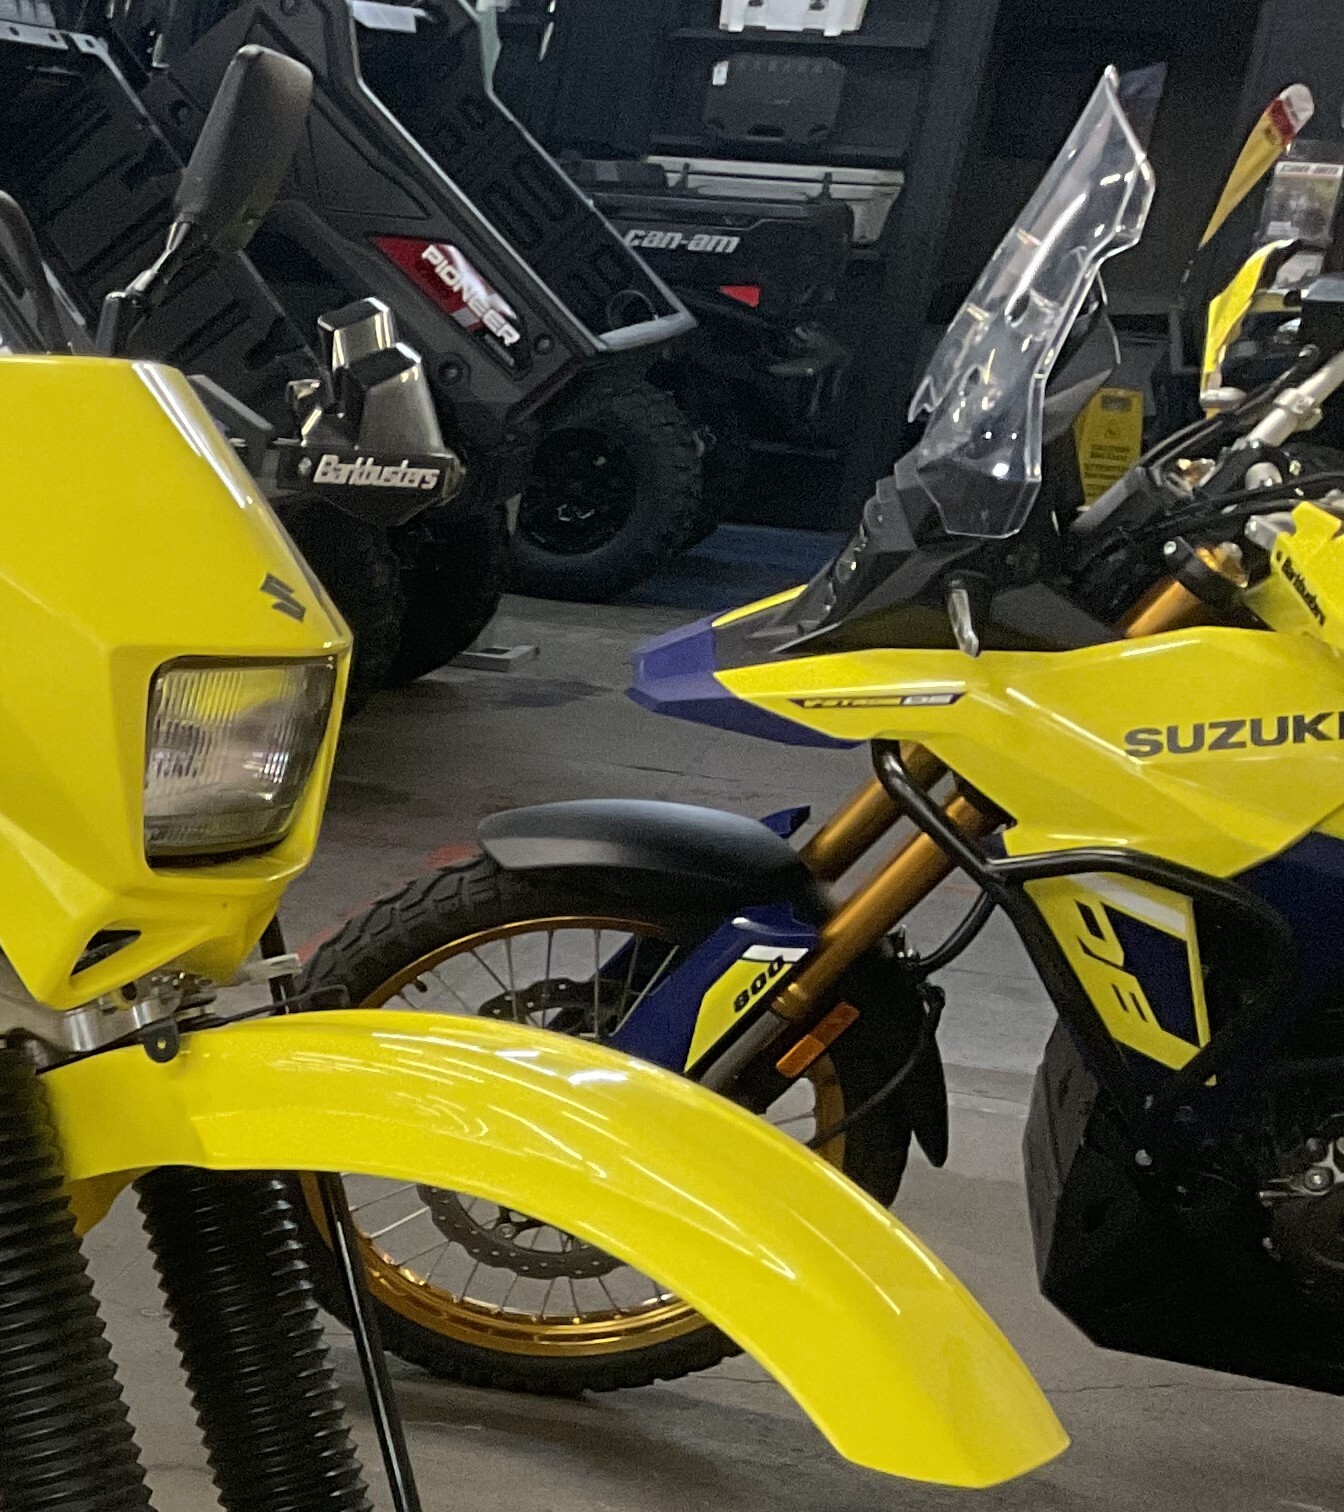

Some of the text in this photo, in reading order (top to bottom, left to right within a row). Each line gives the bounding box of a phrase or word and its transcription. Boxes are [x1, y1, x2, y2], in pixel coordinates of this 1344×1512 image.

[624, 229, 741, 254] can-am
[421, 244, 521, 347] PIONEER
[313, 454, 441, 490] Barkbusters
[733, 955, 785, 1013] 800
